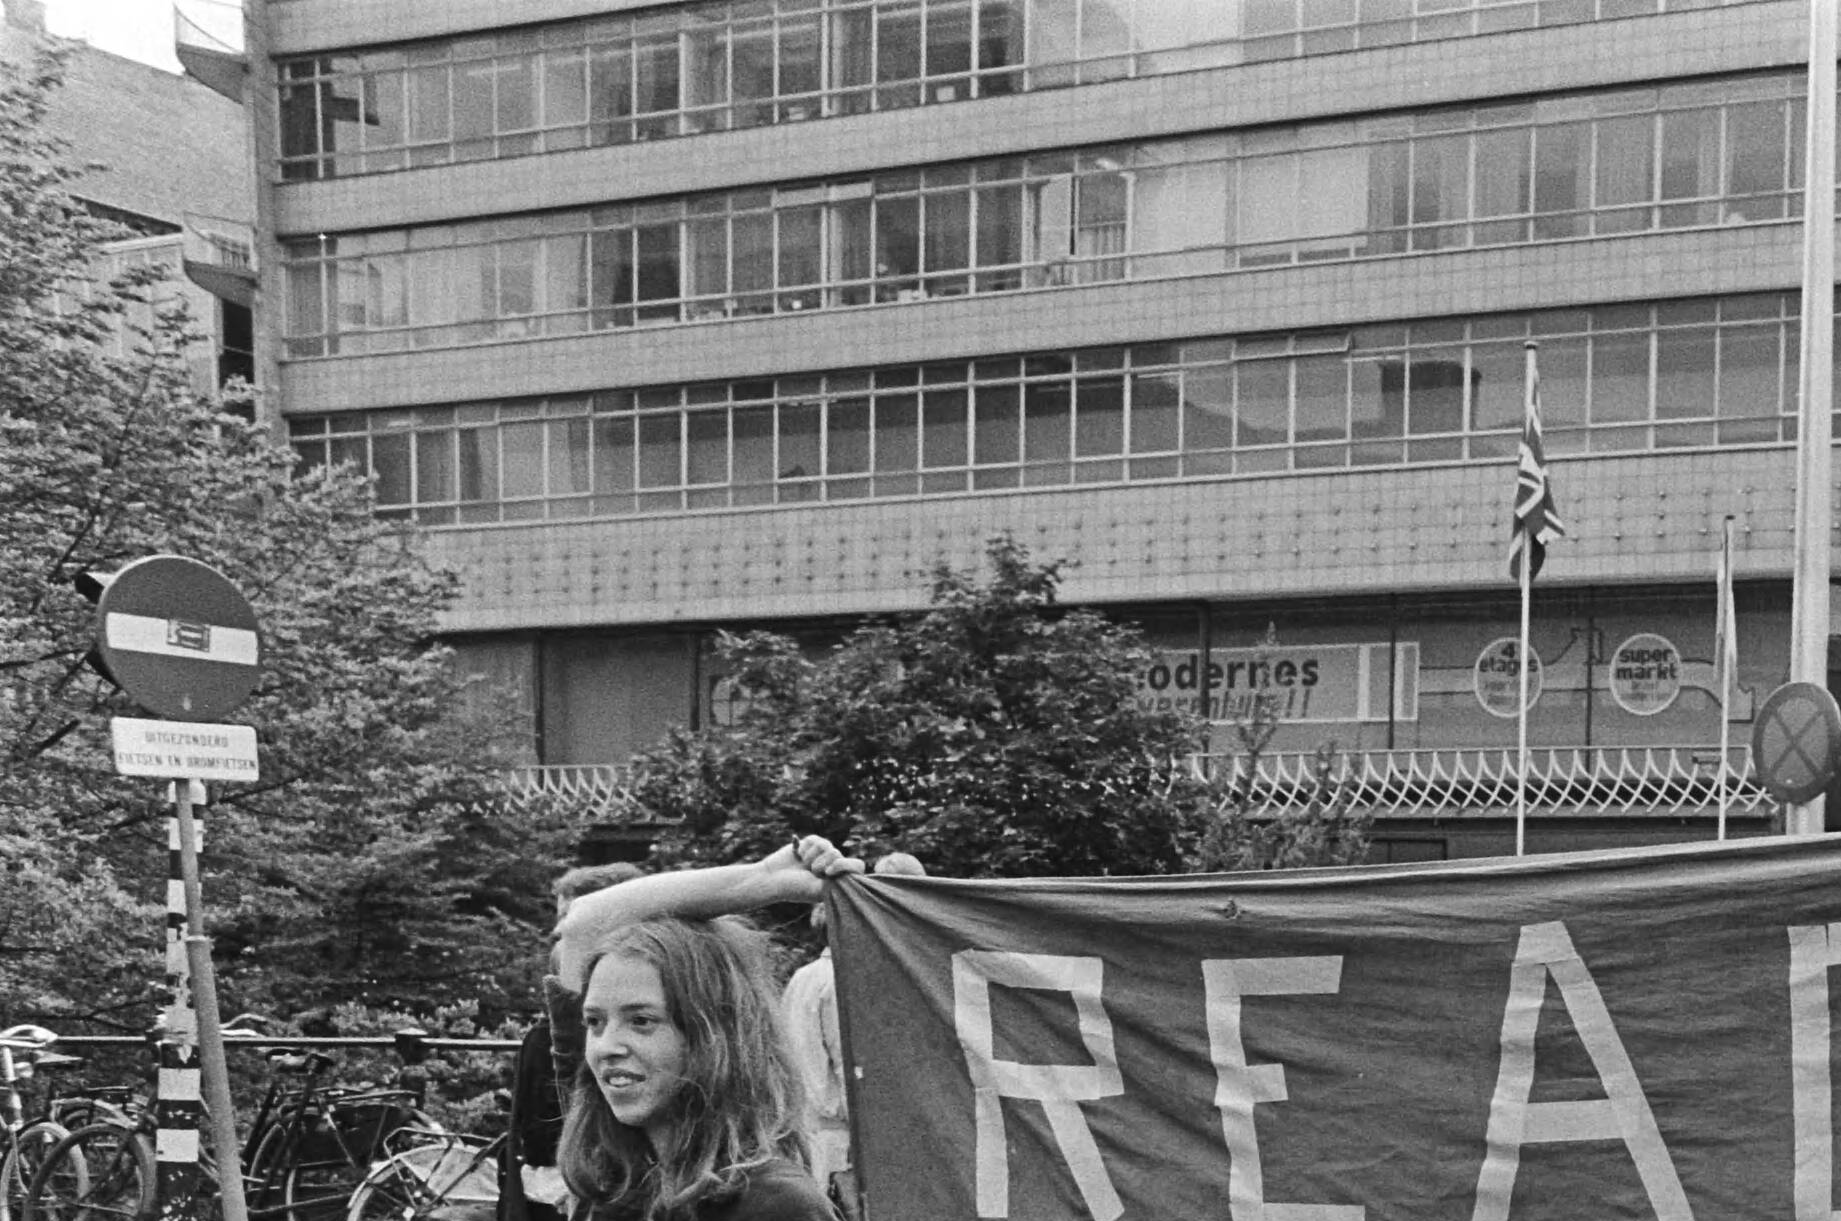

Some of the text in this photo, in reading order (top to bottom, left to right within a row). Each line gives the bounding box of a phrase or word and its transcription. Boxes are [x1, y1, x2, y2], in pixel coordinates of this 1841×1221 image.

[1478, 656, 1539, 677] etags
[1619, 649, 1674, 666] super
[1615, 662, 1679, 681] markt
